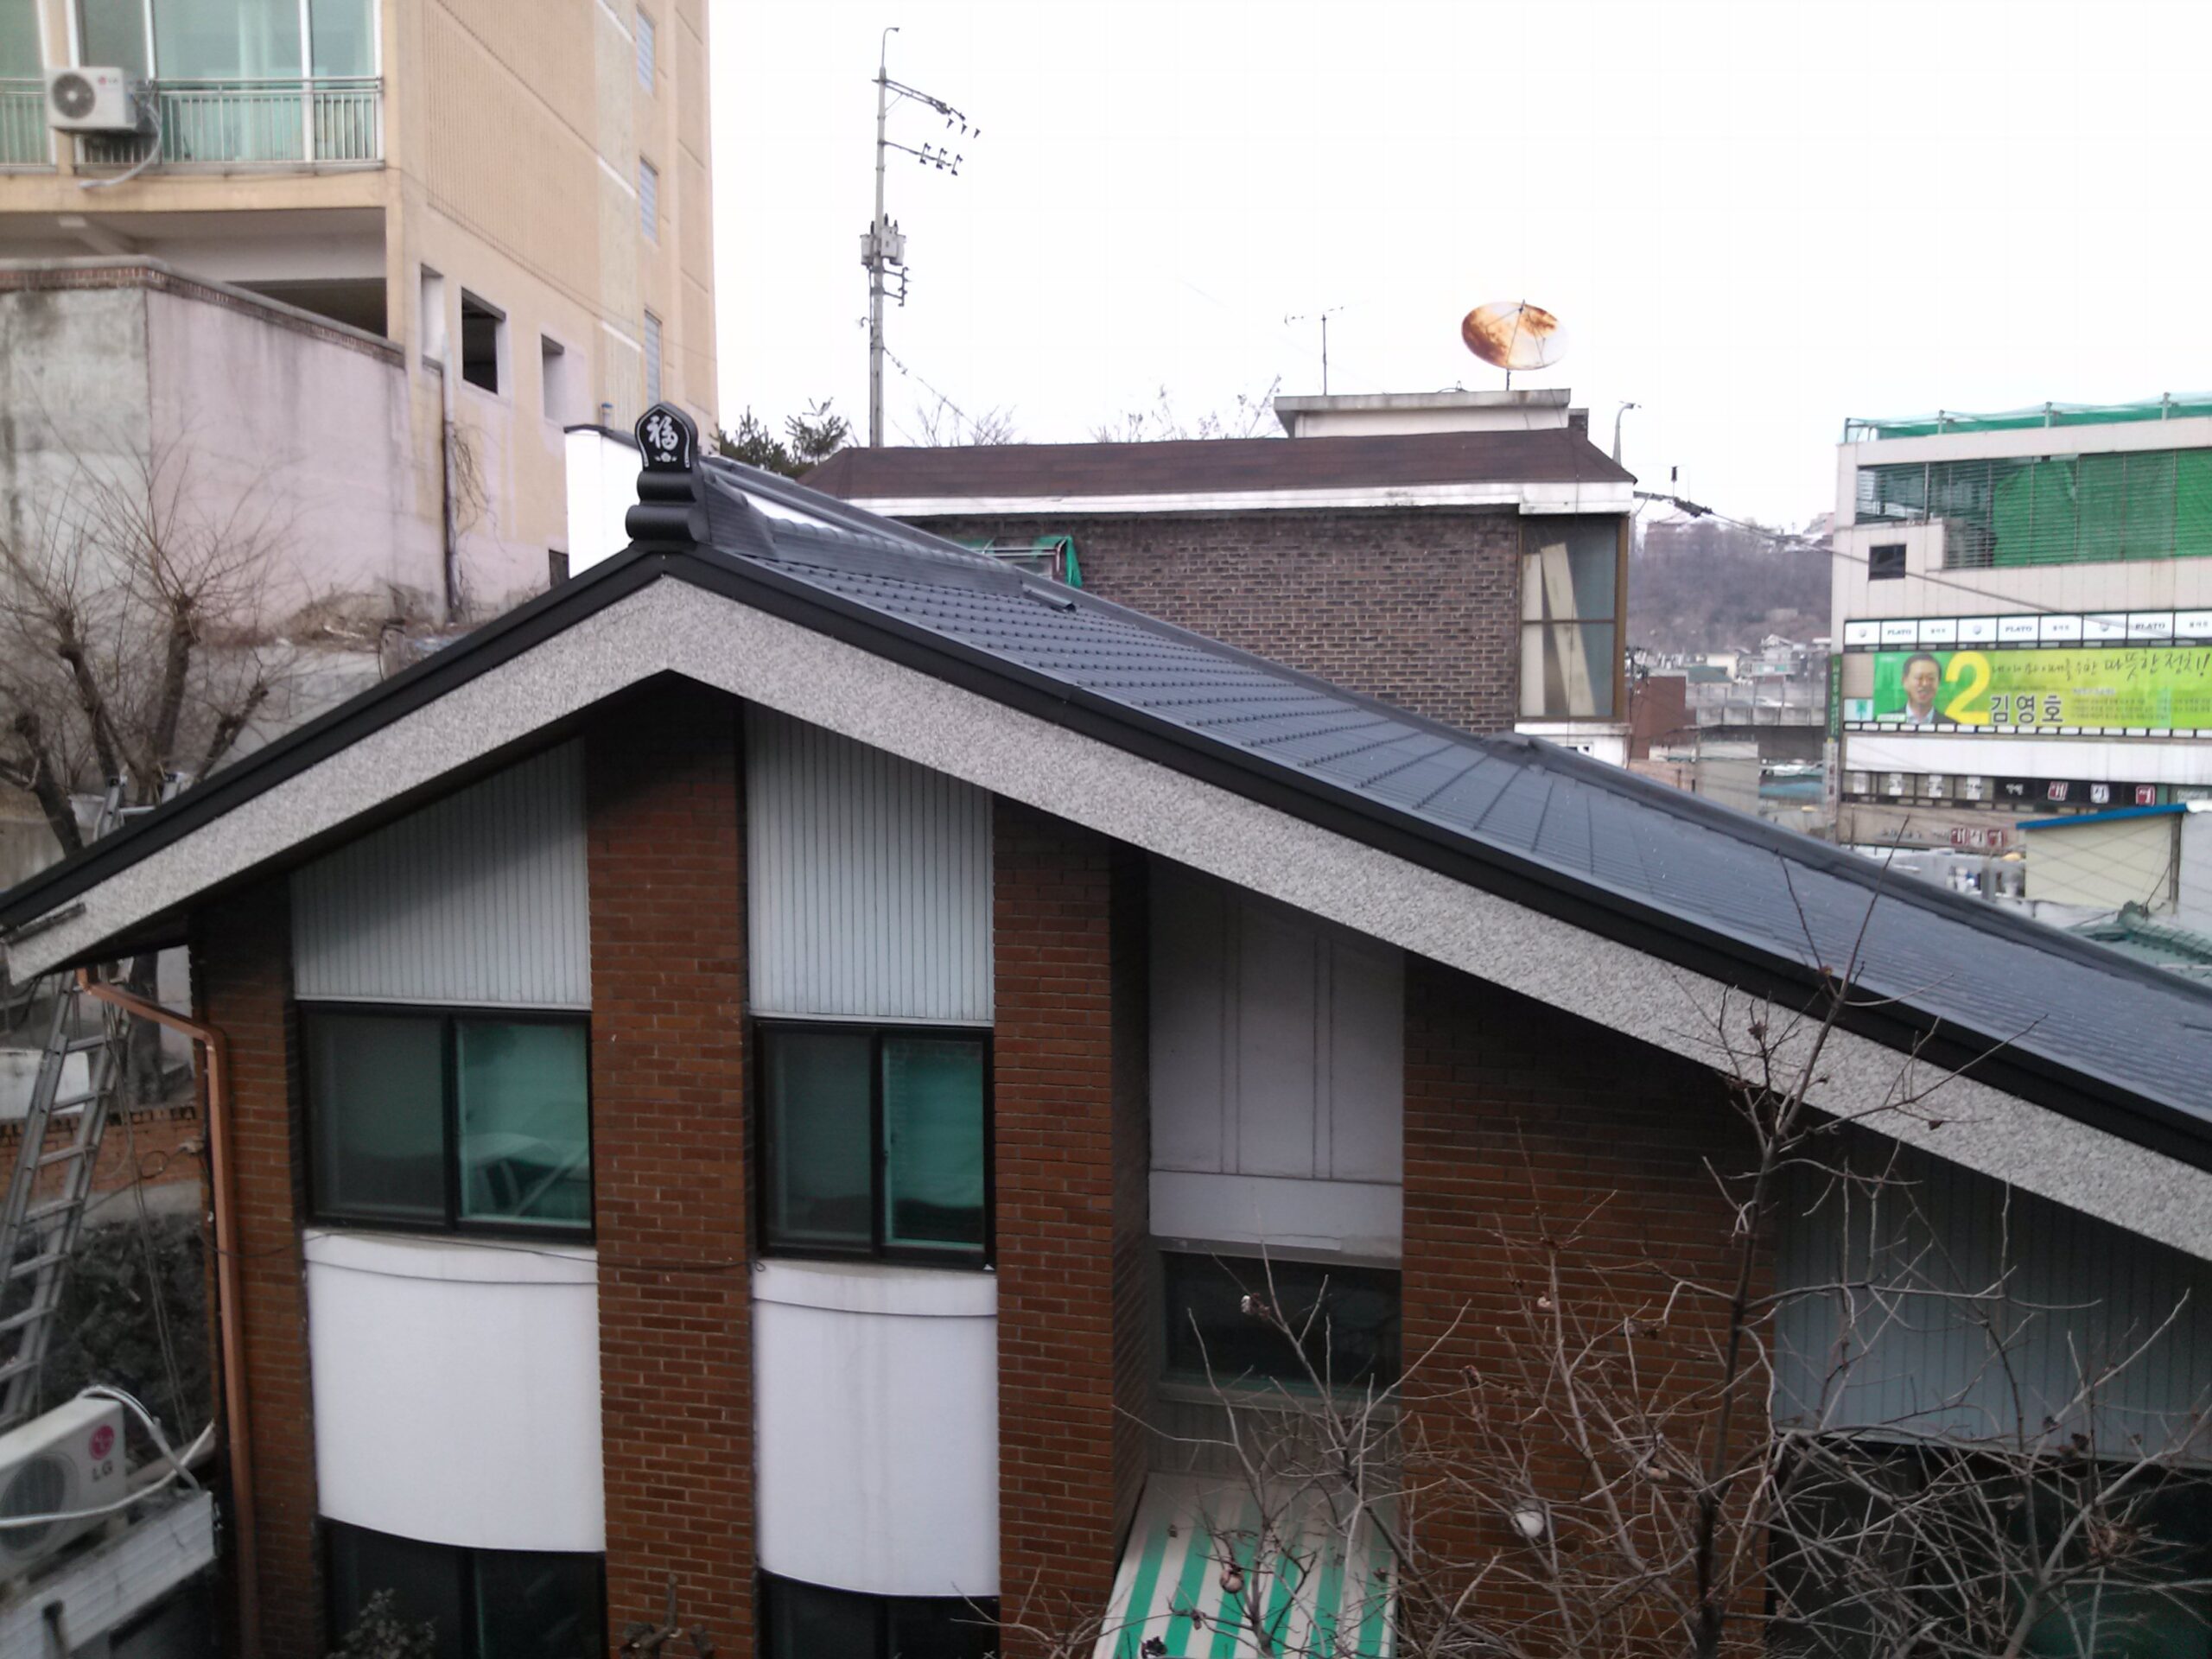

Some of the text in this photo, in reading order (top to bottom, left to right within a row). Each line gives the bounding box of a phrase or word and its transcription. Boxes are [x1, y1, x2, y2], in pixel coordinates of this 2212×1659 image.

[646, 415, 679, 451] 福
[2005, 625, 2033, 633] PLATO
[2134, 622, 2166, 631] PLATO
[1944, 652, 1991, 724] 2
[1990, 694, 2063, 724] 김영호
[92, 1460, 114, 1482] LG
